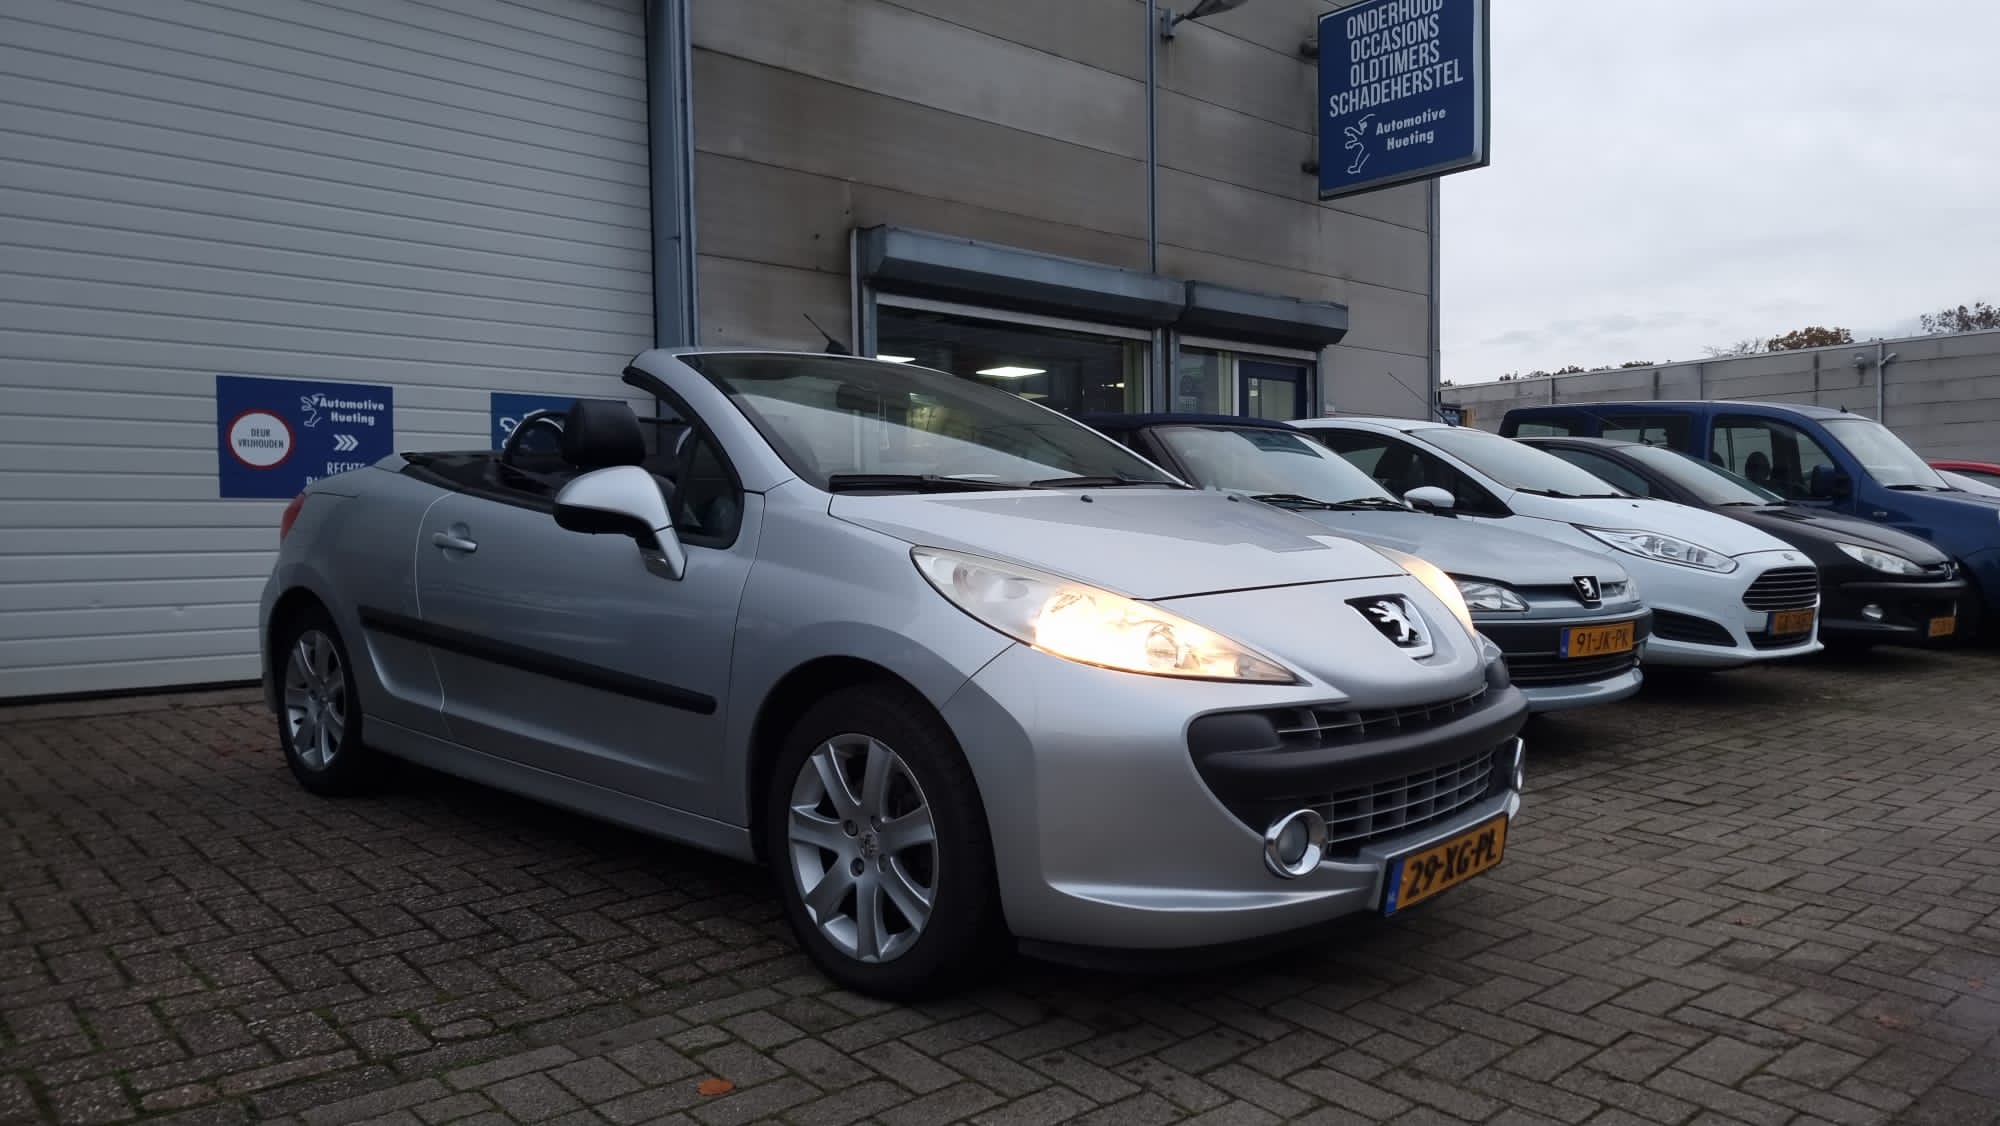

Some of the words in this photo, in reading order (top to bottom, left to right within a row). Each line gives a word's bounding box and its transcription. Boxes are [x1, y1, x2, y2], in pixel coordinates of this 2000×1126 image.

[1351, 14, 1440, 62] OCCASIONS
[1350, 40, 1440, 87] OLDTIMERS
[1329, 58, 1464, 117] SCHADEHERSTEL
[1376, 108, 1447, 135] Automotive
[1387, 130, 1435, 151] Hueting
[320, 397, 385, 411] Automotive
[330, 411, 375, 426] Hueting
[1406, 828, 1496, 900] 29-XG-PL
